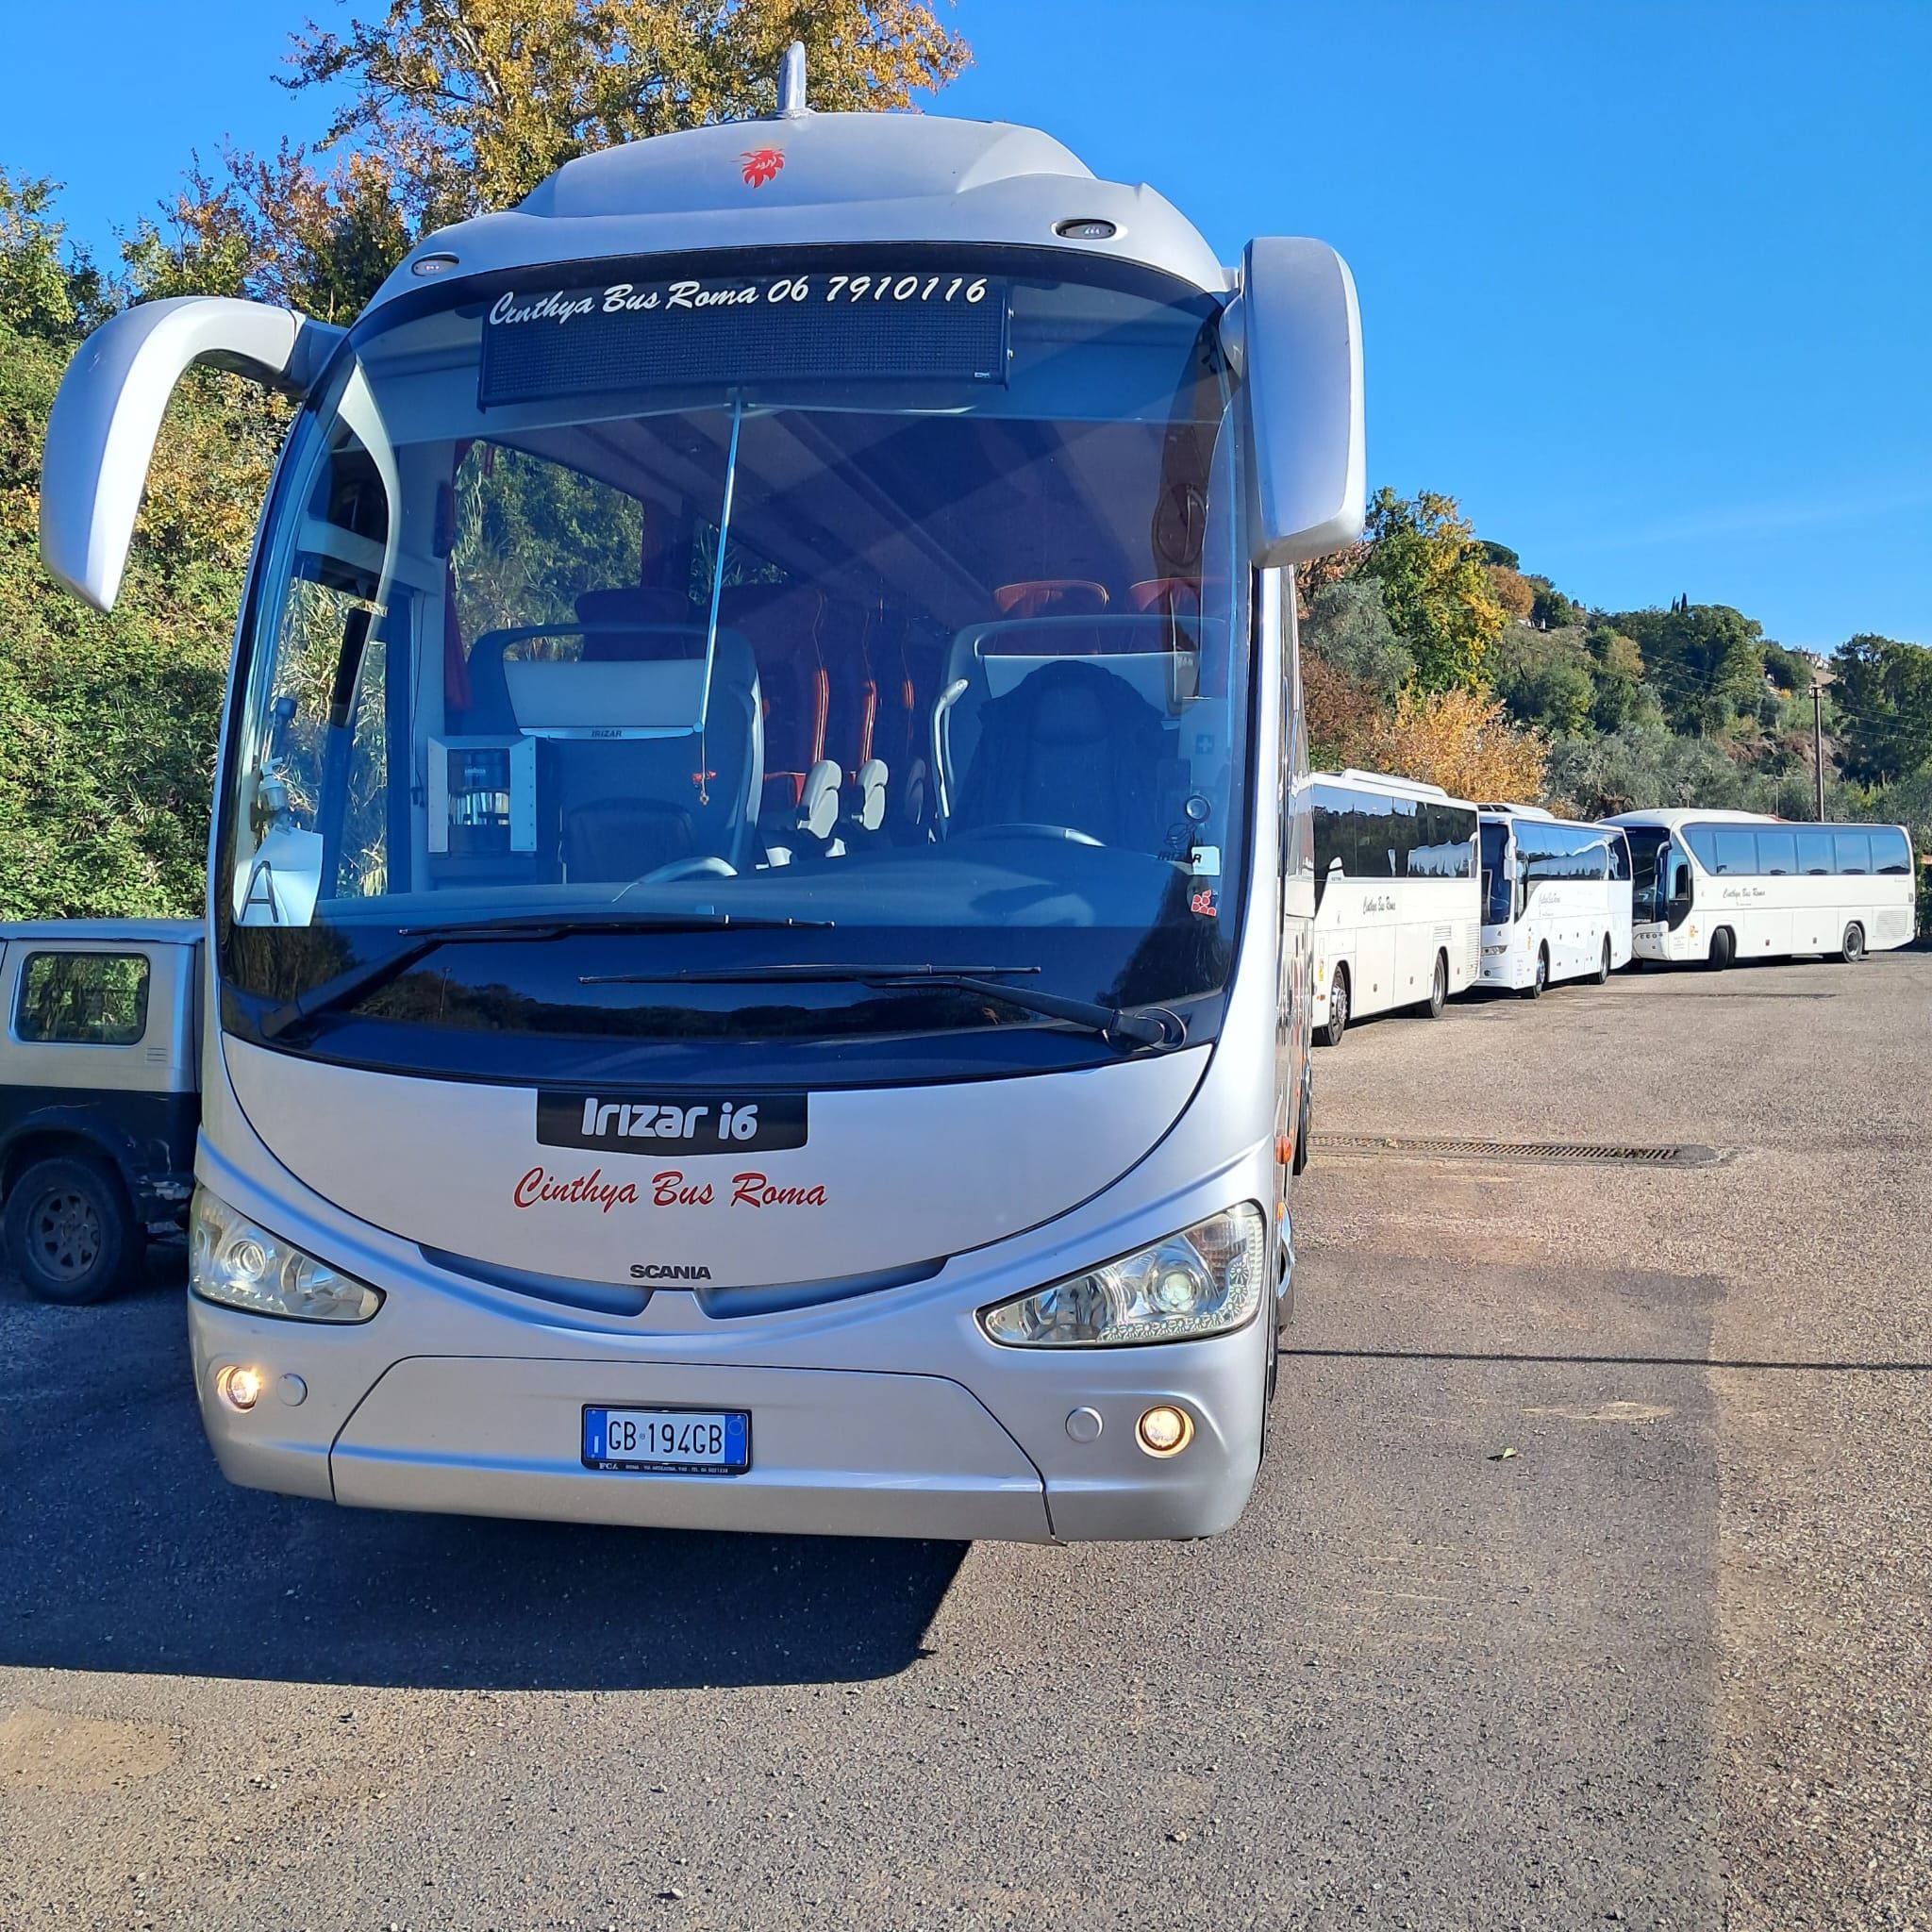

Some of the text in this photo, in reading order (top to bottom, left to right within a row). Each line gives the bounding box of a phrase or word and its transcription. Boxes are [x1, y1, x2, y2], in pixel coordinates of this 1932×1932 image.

[489, 275, 989, 325] Cinthya Bus Roma 06 7910116
[717, 1101, 758, 1141] i6
[513, 1166, 827, 1214] Cinthya Bus Roma
[629, 1263, 712, 1281] SCANIA
